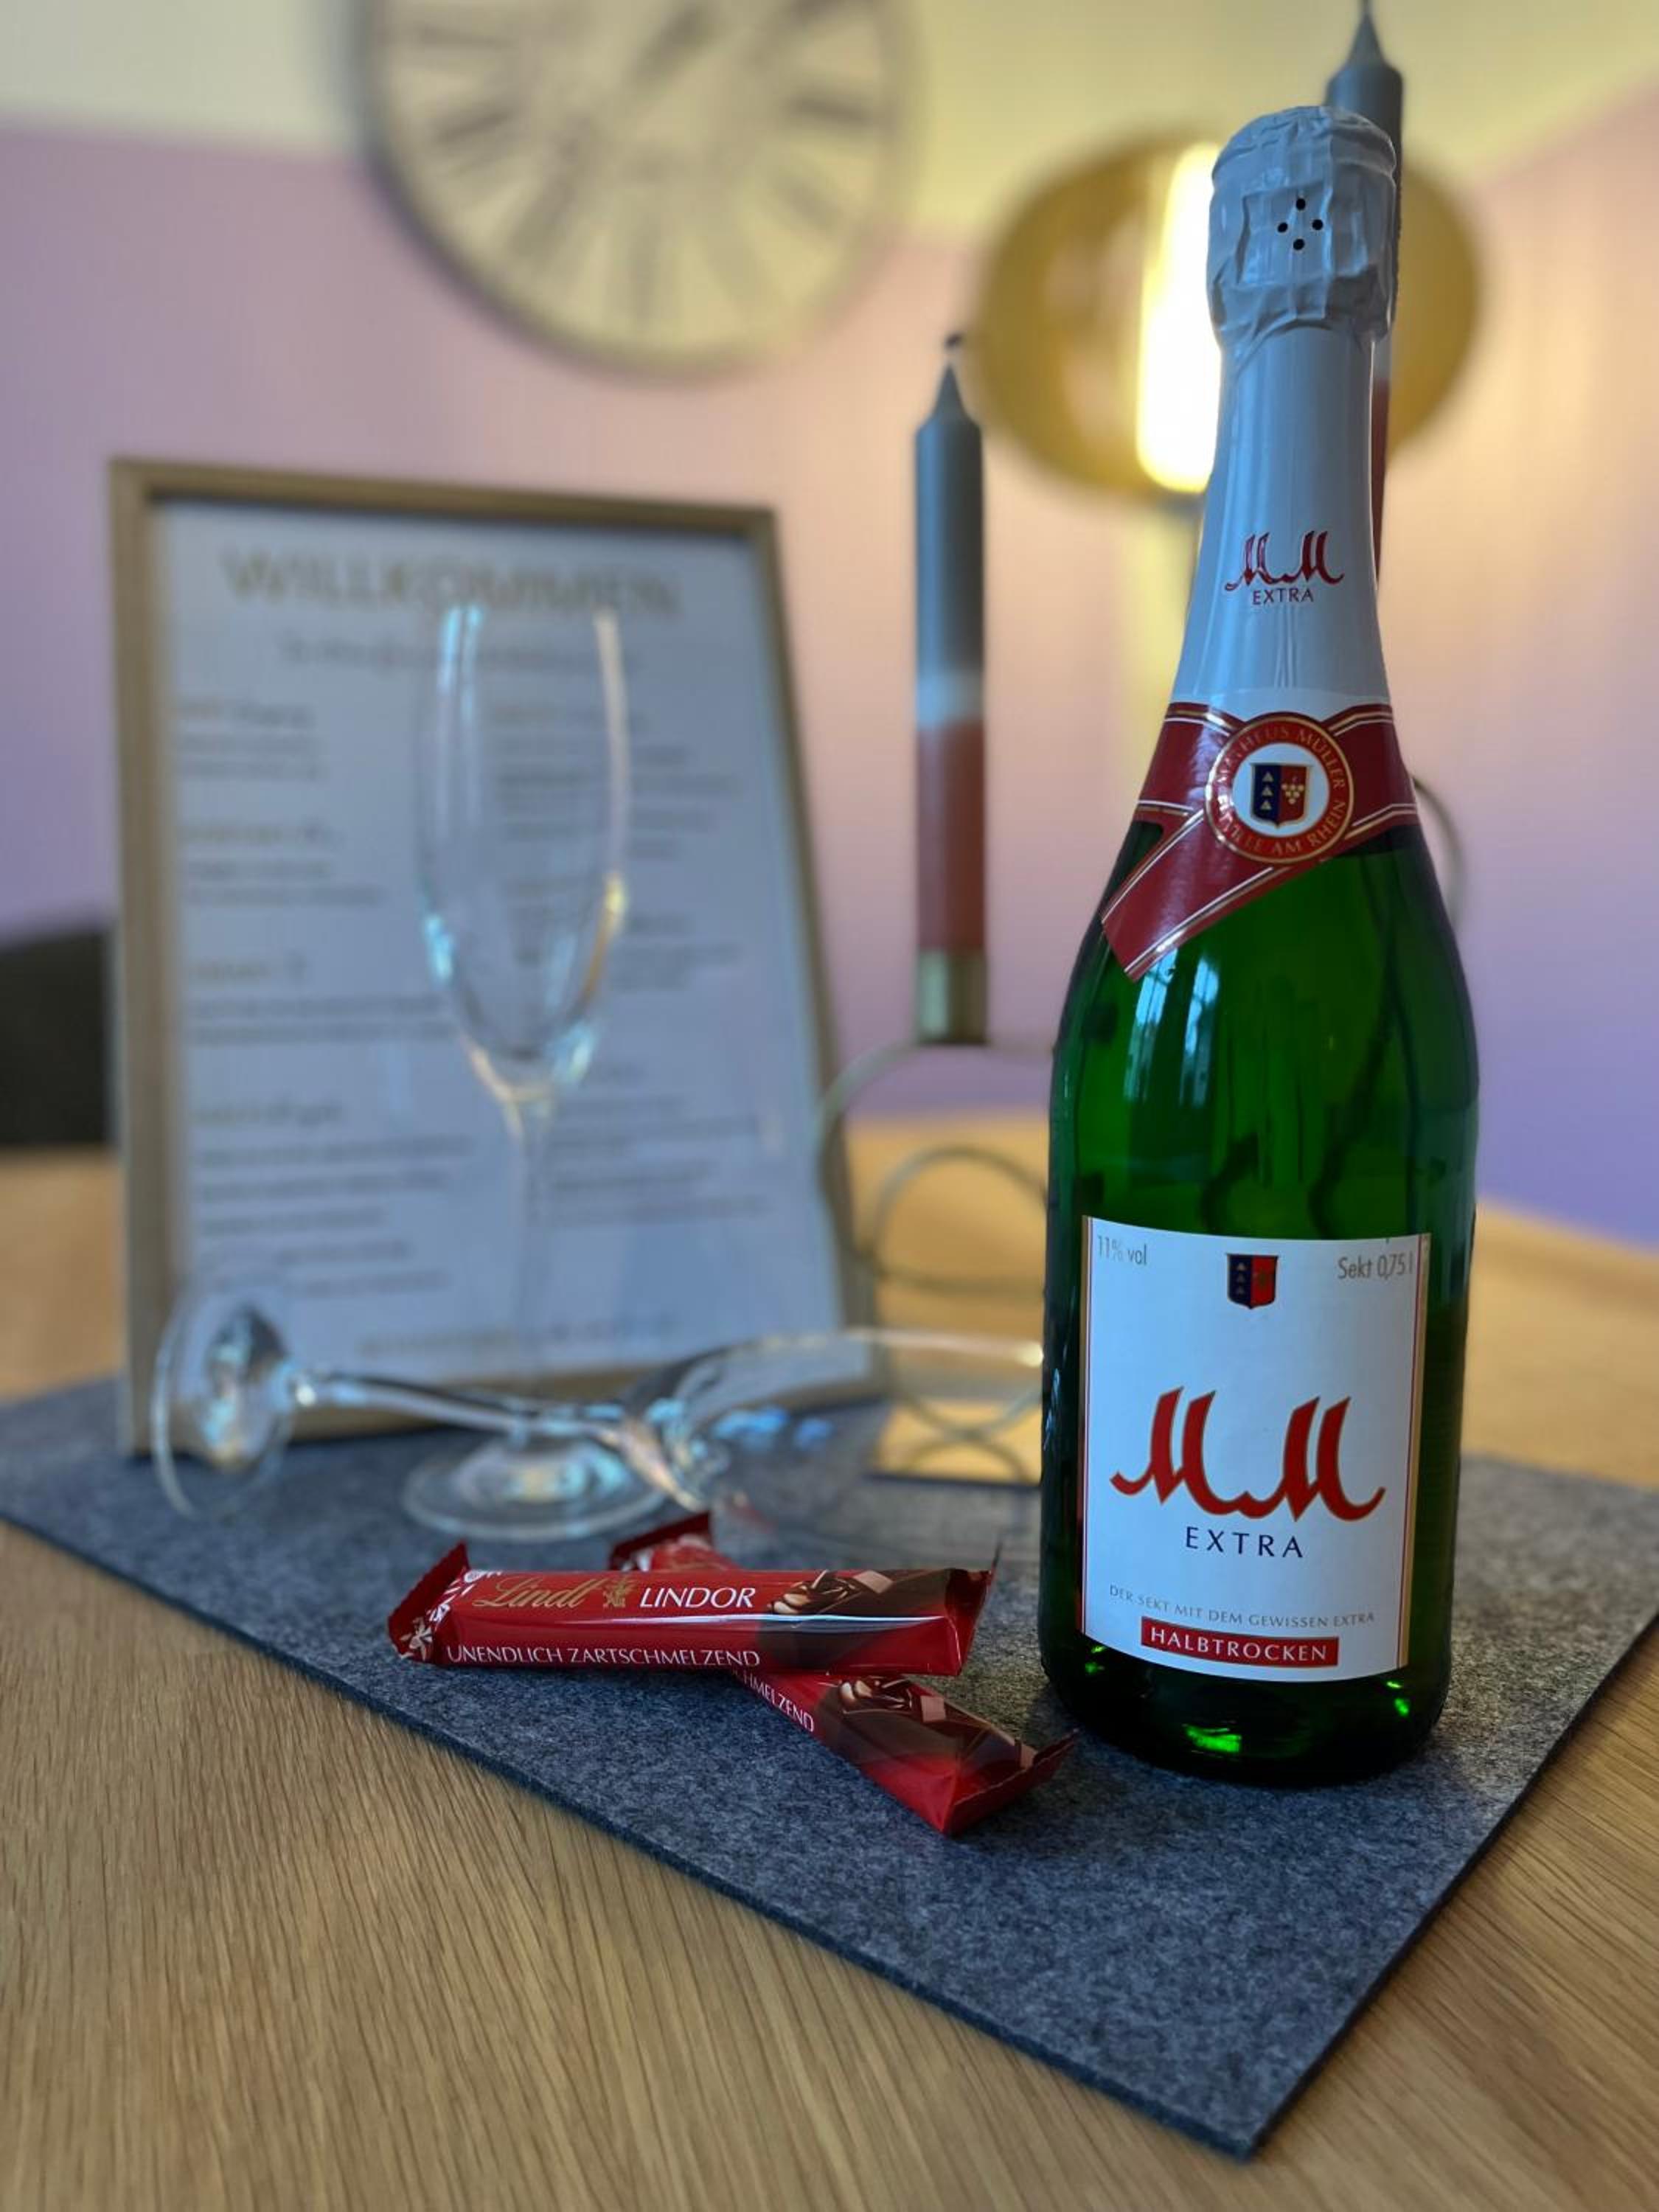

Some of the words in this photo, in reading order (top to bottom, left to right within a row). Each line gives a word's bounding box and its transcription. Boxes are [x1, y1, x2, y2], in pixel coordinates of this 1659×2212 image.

[1252, 588, 1314, 605] EXTRA
[1272, 840, 1302, 857] AM
[1308, 799, 1346, 849] RHEIN
[1096, 1235, 1121, 1262] 11%
[1127, 1243, 1147, 1265] vol
[1338, 1256, 1372, 1279] Sekt
[1376, 1255, 1405, 1279] 0,75
[1185, 1526, 1304, 1559] EXTRA
[471, 1576, 605, 1609] Lindt
[639, 1587, 757, 1609] LINDOR
[1109, 1583, 1134, 1604] DER
[1138, 1593, 1170, 1613] SEKT
[1175, 1603, 1203, 1620] MIT
[1208, 1609, 1242, 1626] DEM
[1248, 1613, 1328, 1628] GEWISSEN
[1333, 1612, 1376, 1628] EXTRA
[447, 1644, 563, 1664] UNENDLICH
[569, 1646, 761, 1667] ZARTSCHMELZEND
[1150, 1627, 1327, 1662] HALBTROCKEN
[733, 1669, 815, 1732] HMELZEND
